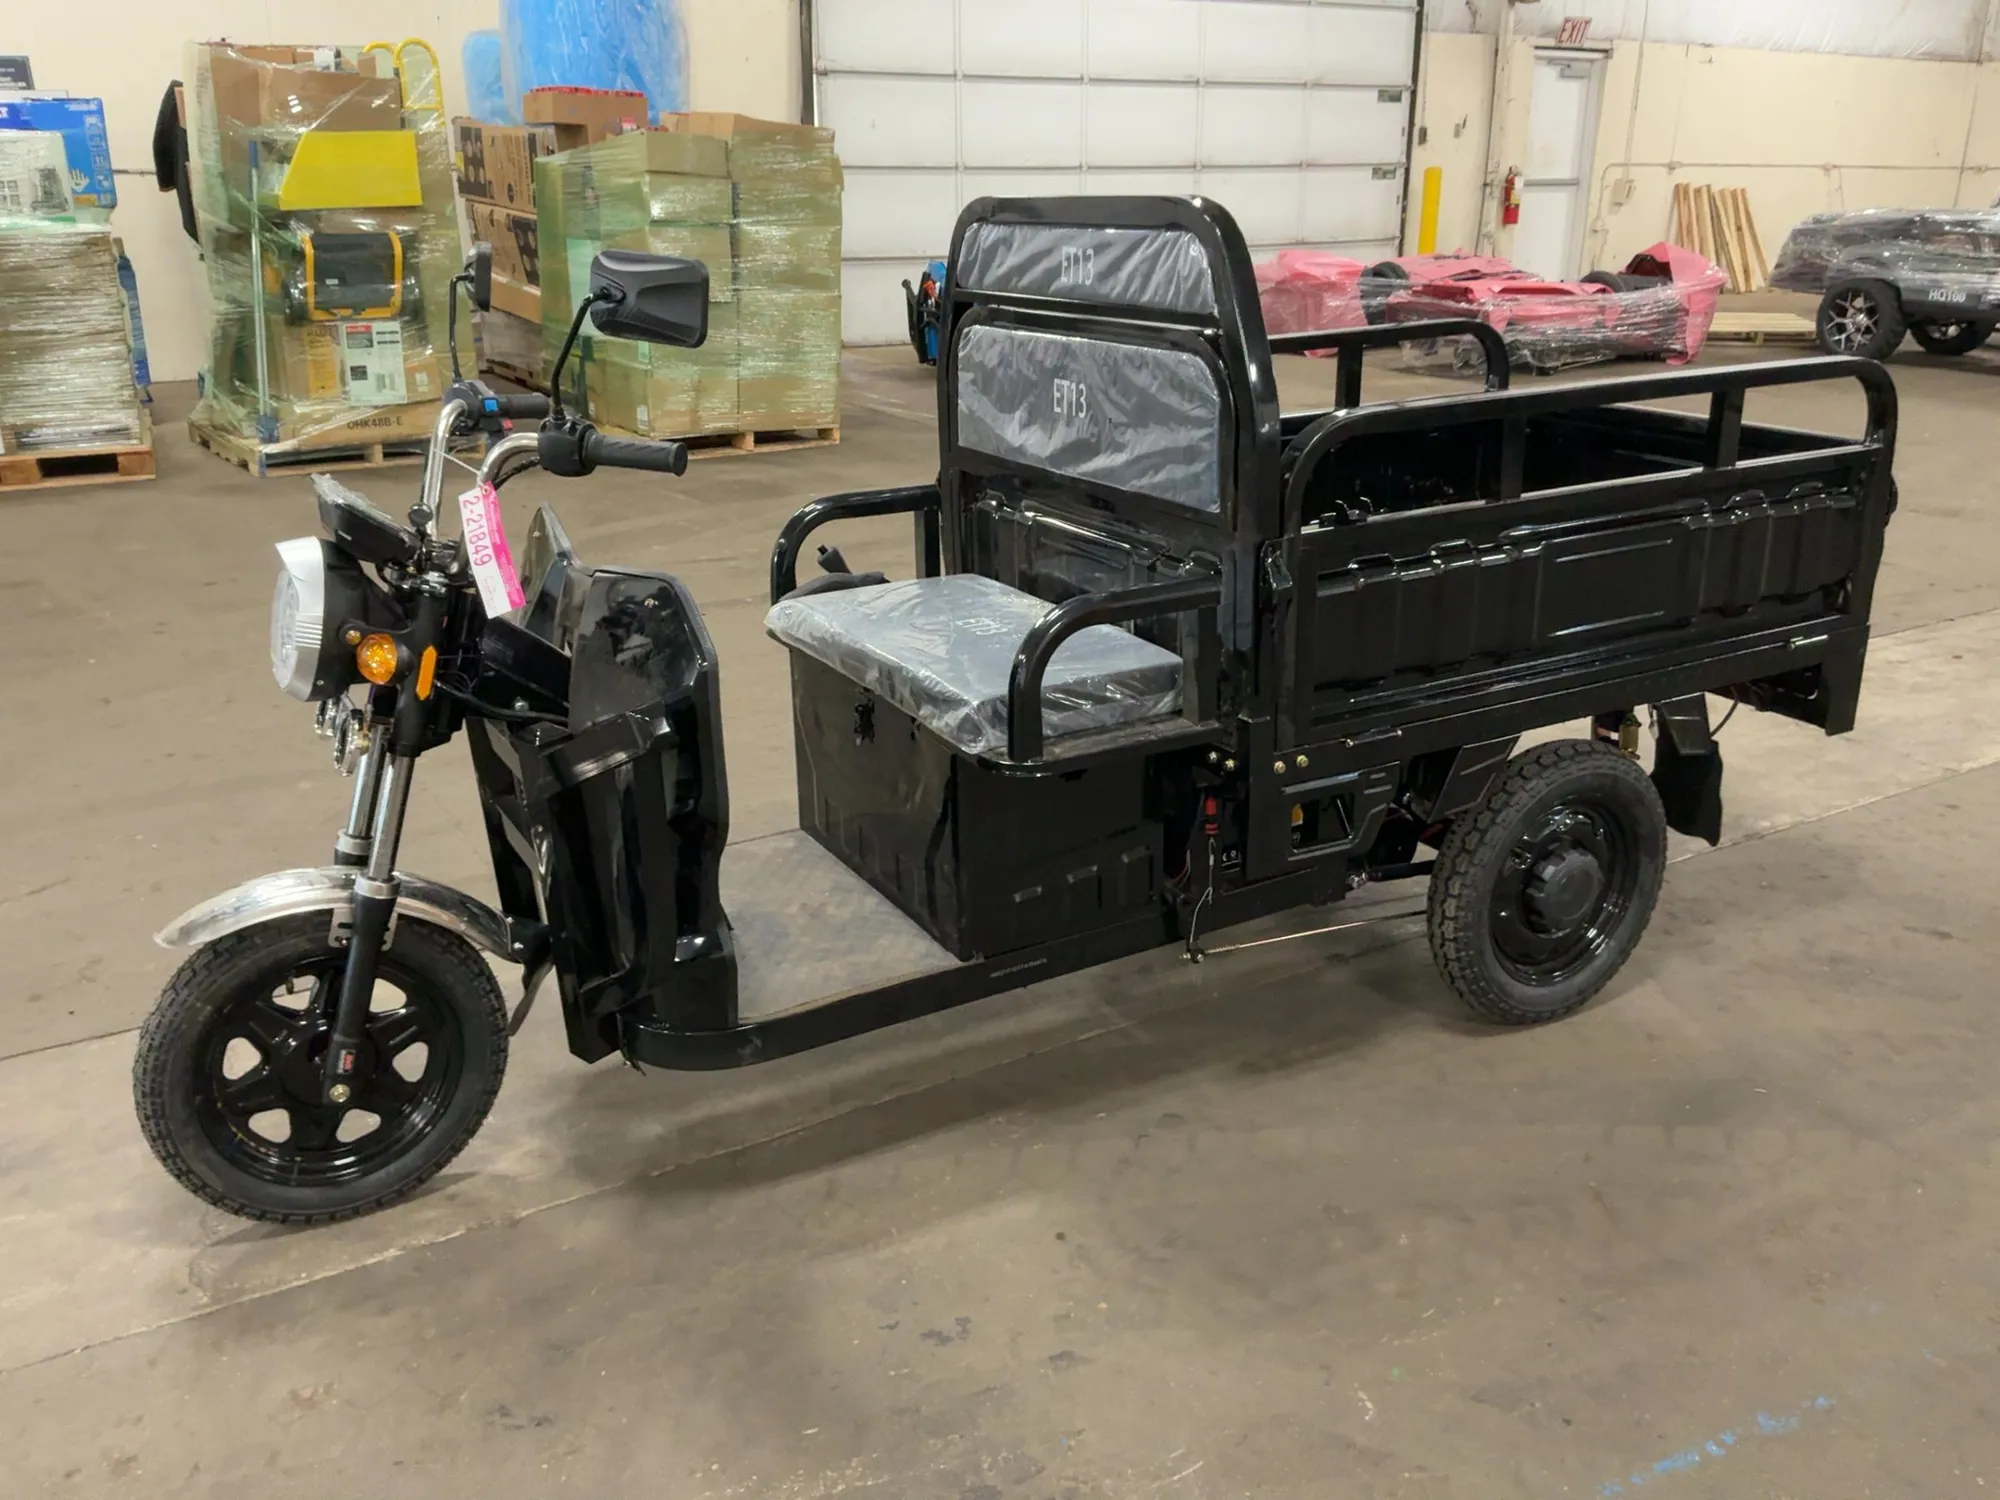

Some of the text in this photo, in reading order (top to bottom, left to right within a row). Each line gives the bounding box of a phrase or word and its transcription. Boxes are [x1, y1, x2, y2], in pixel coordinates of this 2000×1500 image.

[1558, 19, 1591, 44] EXIT
[1061, 246, 1094, 286] ET13
[1053, 377, 1087, 418] ET13
[462, 495, 492, 567] 2-21849
